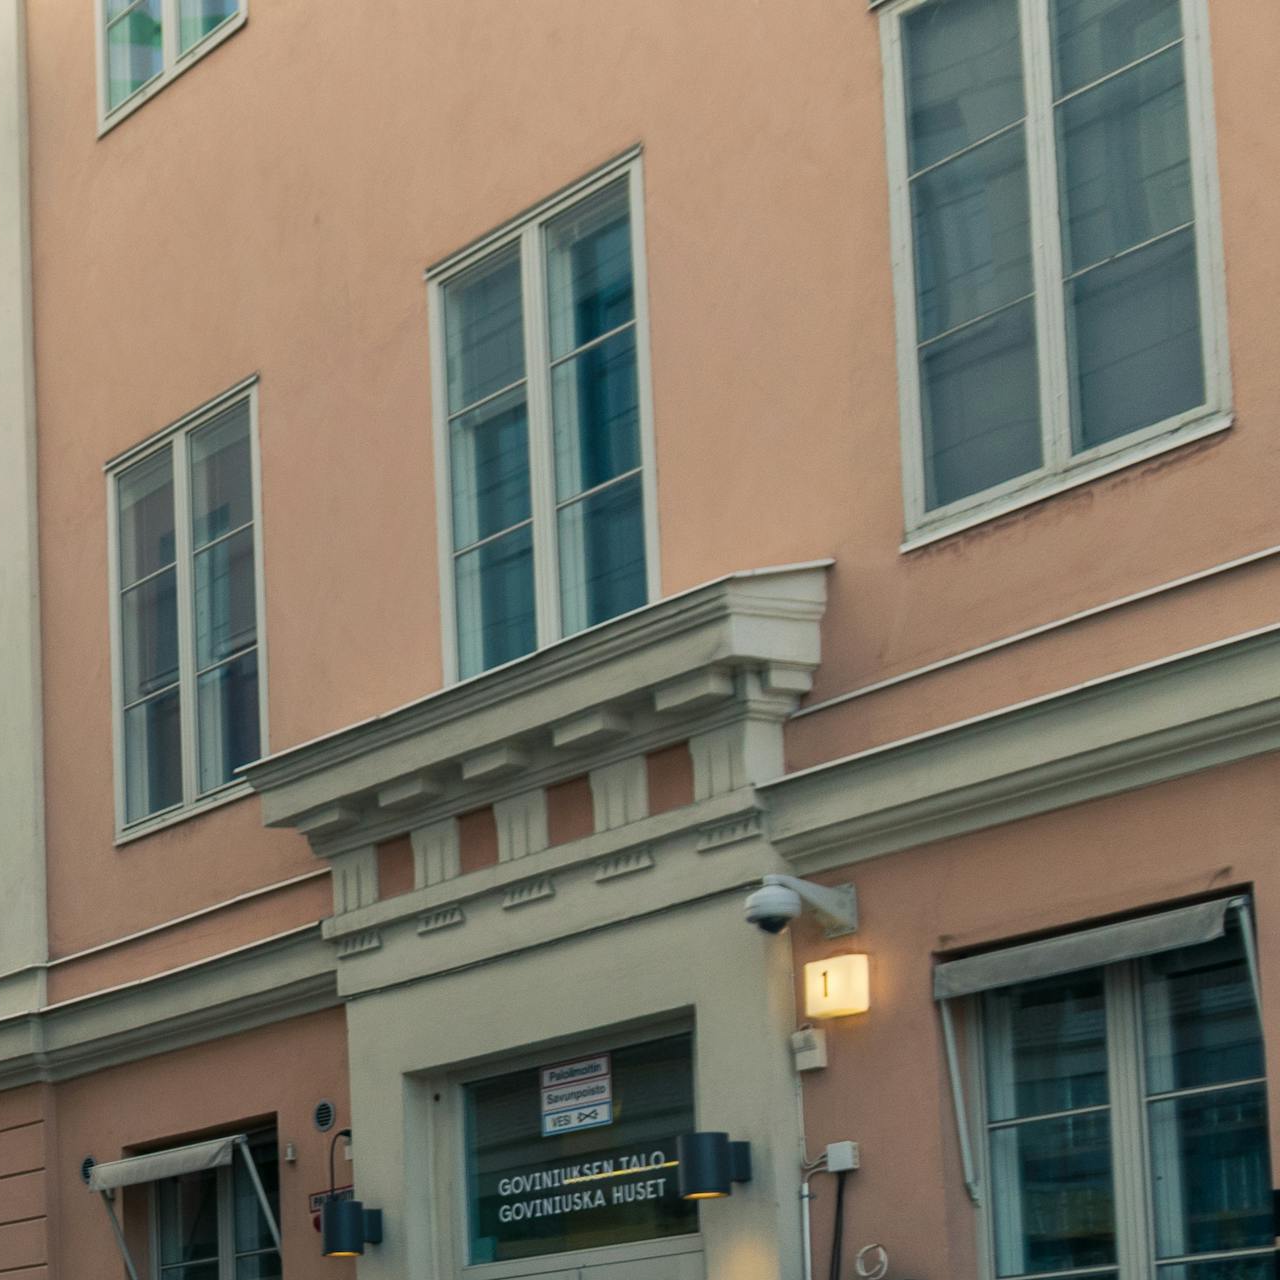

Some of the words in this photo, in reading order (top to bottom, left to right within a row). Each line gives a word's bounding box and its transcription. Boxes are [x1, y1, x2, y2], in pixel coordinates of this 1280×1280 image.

[822, 969, 829, 998] 1
[550, 1114, 572, 1128] VESI
[498, 1158, 615, 1197] GOVINIUKSEN
[619, 1150, 666, 1171] TALO
[498, 1188, 607, 1223] GOVINIUSKA
[612, 1177, 667, 1205] HUSET
